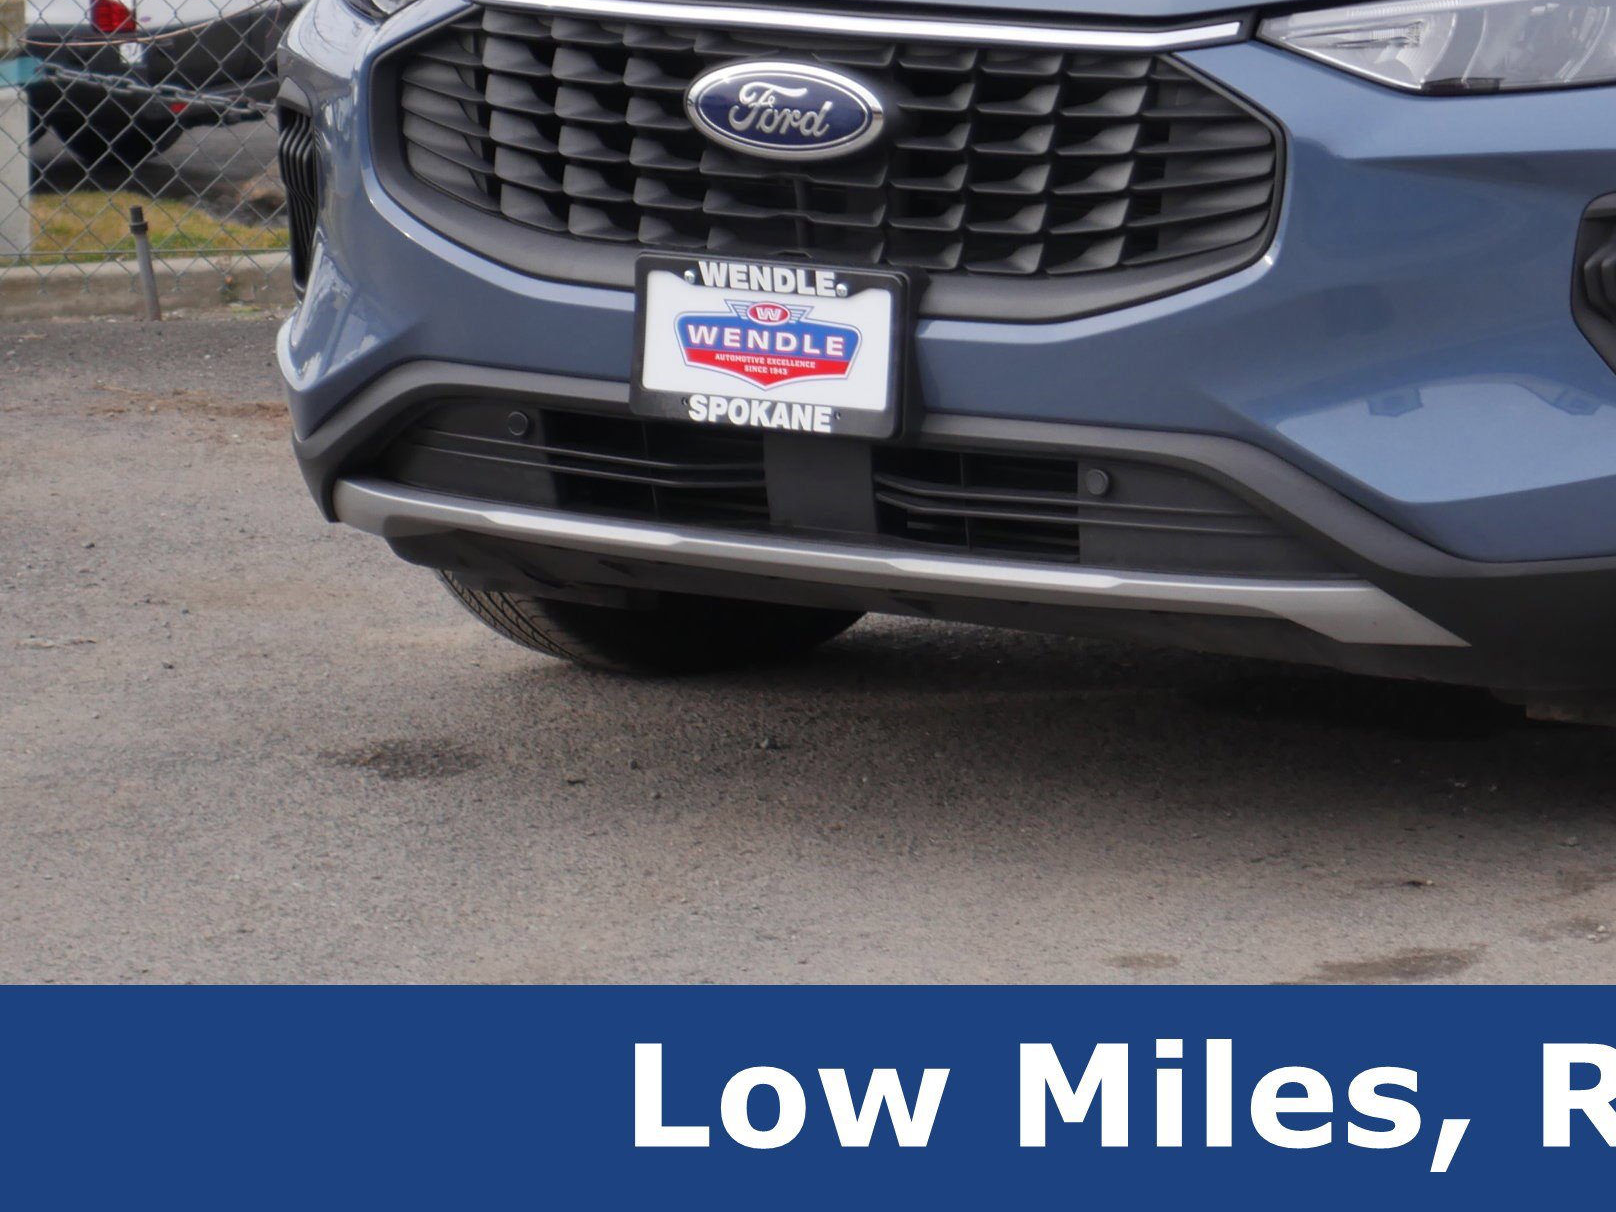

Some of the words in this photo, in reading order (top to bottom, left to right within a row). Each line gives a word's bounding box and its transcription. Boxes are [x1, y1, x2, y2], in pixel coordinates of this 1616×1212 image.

[728, 80, 833, 138] Ford
[698, 260, 837, 298] WENDLE
[687, 323, 845, 357] WENDLE
[714, 352, 766, 365] AUTOMOTIVE
[766, 356, 816, 369] EXCELLENCE
[743, 365, 768, 374] SINCE
[769, 366, 789, 376] 1943
[688, 394, 832, 434] SPOKANE
